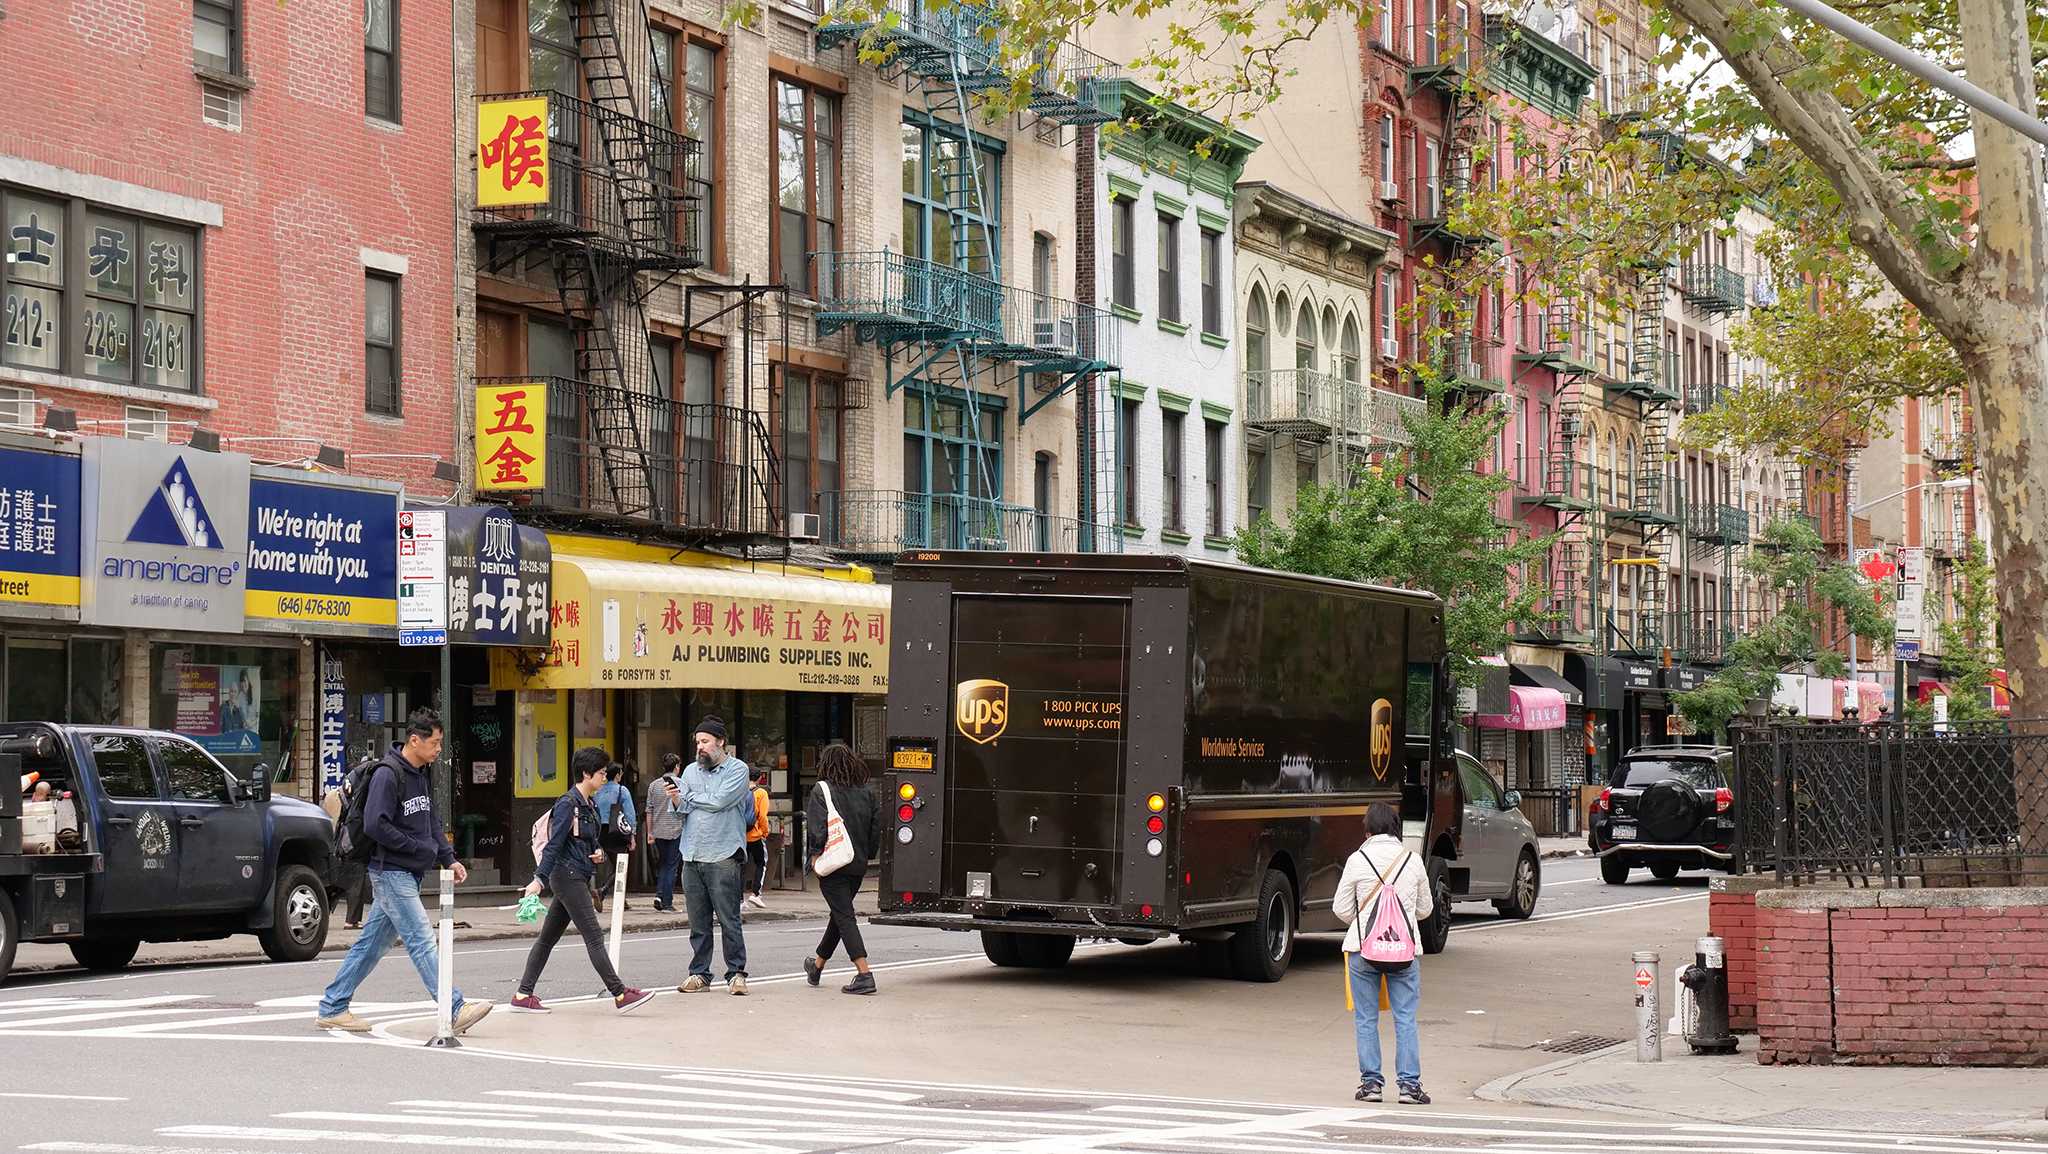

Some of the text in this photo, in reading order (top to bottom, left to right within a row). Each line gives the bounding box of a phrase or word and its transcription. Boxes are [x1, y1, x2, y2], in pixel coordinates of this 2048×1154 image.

[480, 114, 545, 191] 喉
[143, 318, 184, 372] 2161
[484, 390, 536, 484] 五金
[257, 506, 363, 547] We're right at
[485, 516, 513, 528] BOSS
[103, 555, 232, 585] americare
[247, 540, 369, 584] home with you.
[480, 561, 517, 576] DENTAL
[0, 578, 30, 596] treet
[139, 593, 173, 606] tradition
[174, 595, 183, 607] of
[184, 597, 208, 612] caring
[278, 595, 351, 616] (646) 476-8300
[551, 600, 580, 628] 水喉
[660, 598, 884, 645] 永興水喉五金公司
[401, 636, 434, 644] 101928
[551, 639, 580, 668] 公司
[672, 644, 872, 669] AJ PLUMBING SUPPLIES INC.
[602, 668, 672, 681] 86 FORSYTH ST.
[872, 675, 889, 687] FAX:
[324, 682, 345, 691] ENTAL
[960, 698, 1005, 734] ups
[1043, 700, 1122, 714] 1 800 PICK UPS
[1043, 717, 1121, 731] www.ups.com
[1201, 736, 1265, 758] Worldwide Services
[1371, 723, 1391, 768] ups
[1372, 941, 1406, 952] adidas
